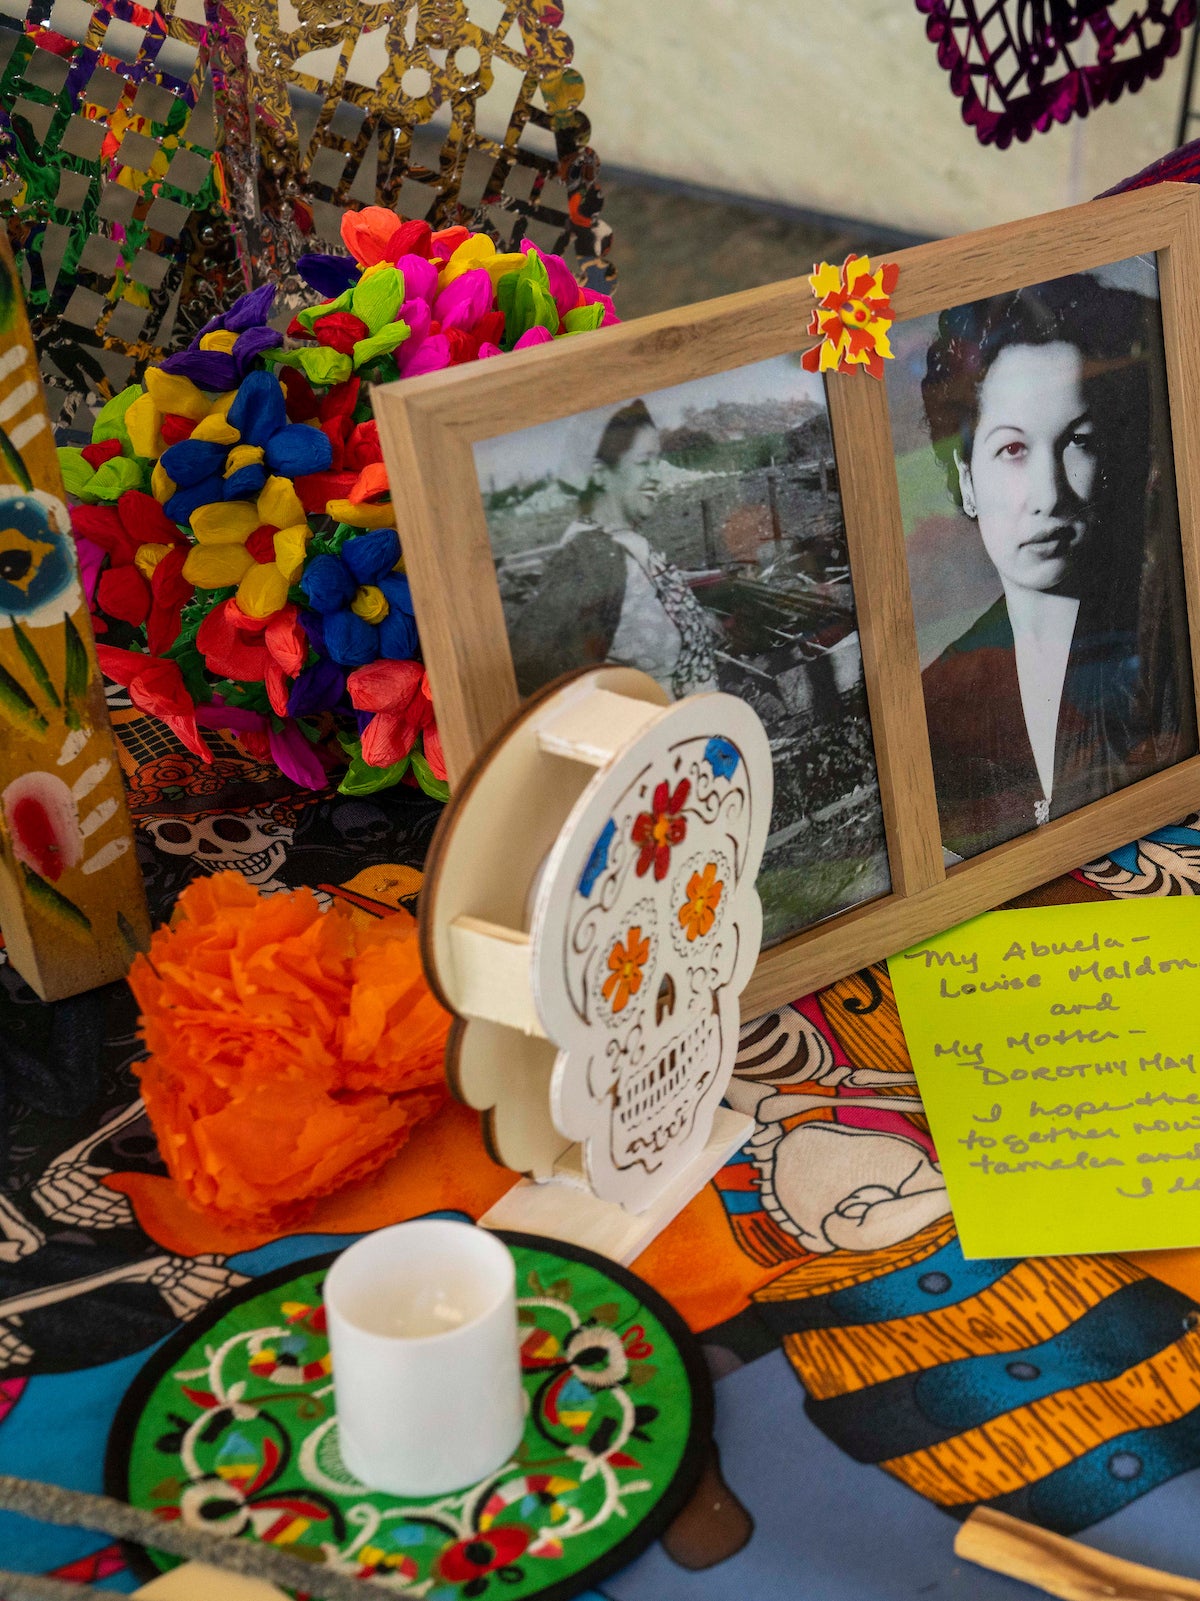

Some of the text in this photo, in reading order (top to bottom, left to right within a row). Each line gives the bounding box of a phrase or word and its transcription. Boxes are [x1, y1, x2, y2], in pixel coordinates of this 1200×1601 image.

[904, 949, 979, 974] My
[940, 974, 1041, 998] Louise
[1050, 993, 1120, 1015] and
[934, 1040, 984, 1066] My
[974, 1059, 1127, 1086] DOROTHY
[1139, 1053, 1196, 1073] MAY
[972, 1103, 1002, 1123] I
[958, 1127, 1120, 1154] together
[969, 1151, 1125, 1174] tamales
[1116, 1176, 1154, 1198] I
